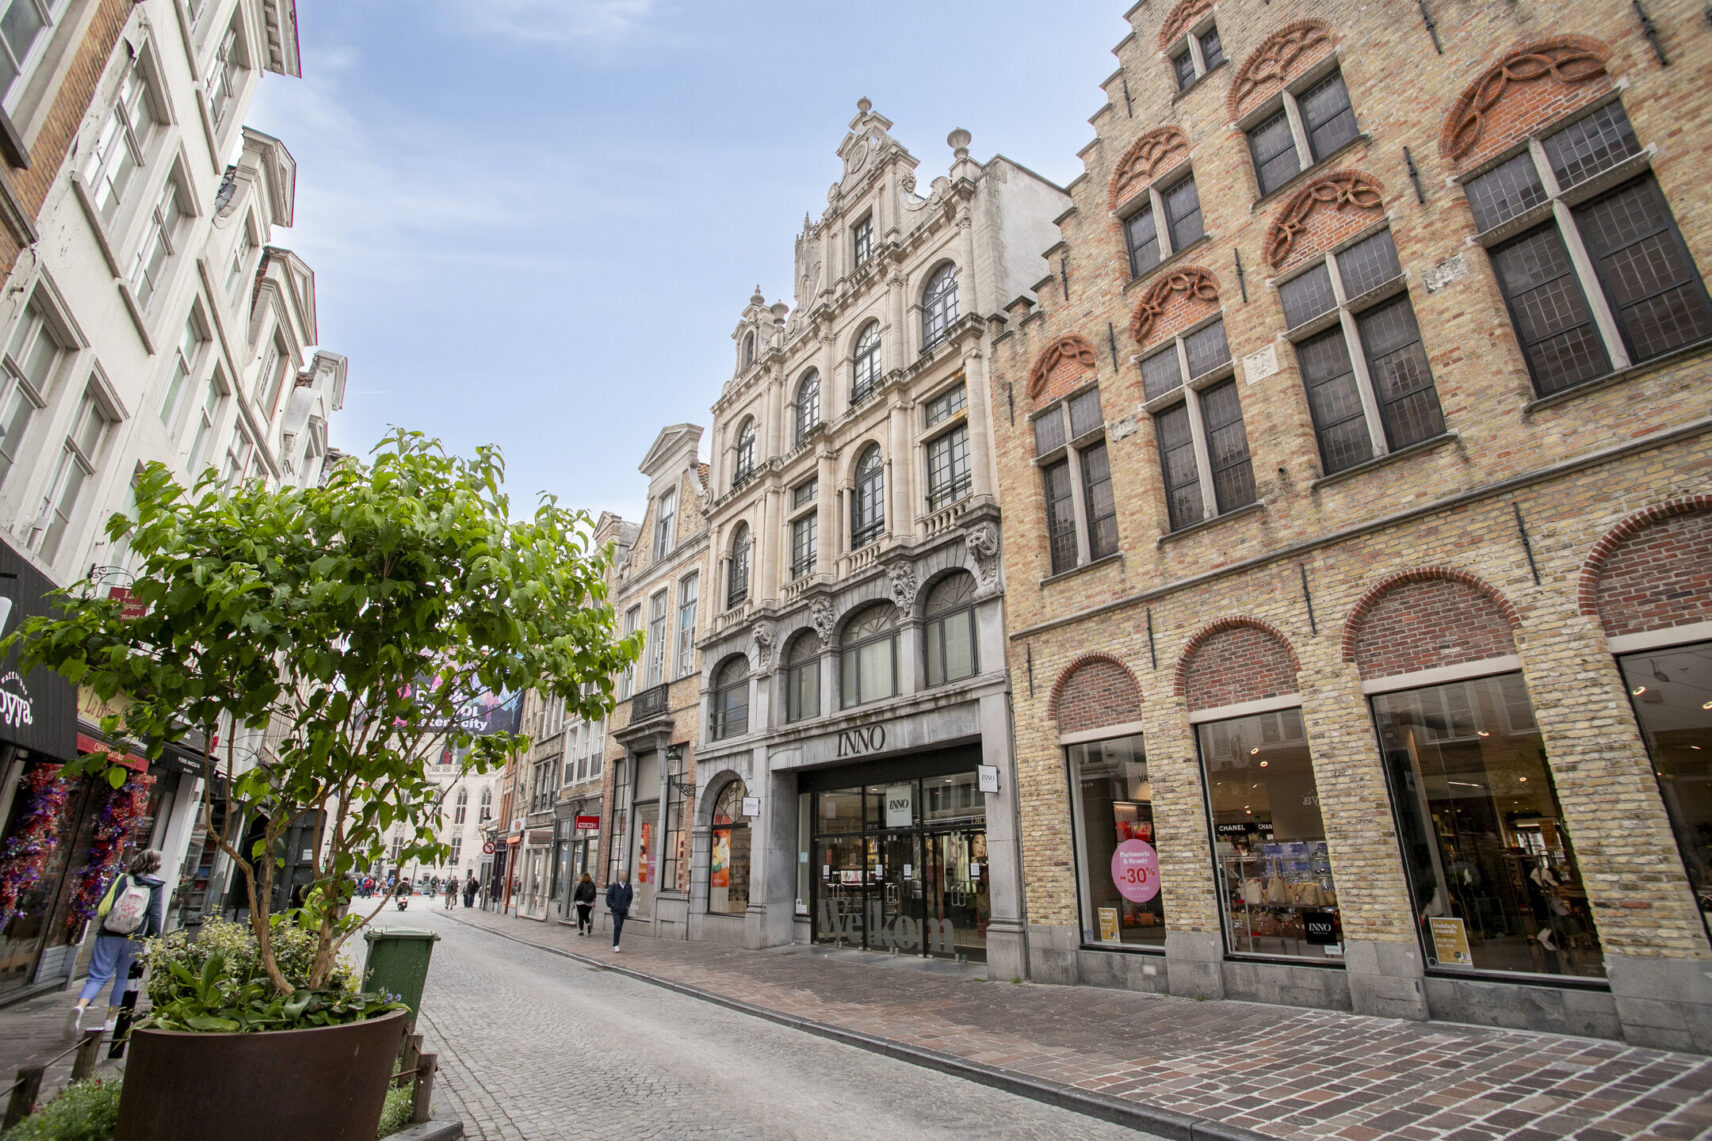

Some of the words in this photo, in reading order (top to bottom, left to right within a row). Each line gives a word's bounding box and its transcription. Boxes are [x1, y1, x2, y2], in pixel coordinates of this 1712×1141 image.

[461, 719, 488, 731] city
[836, 724, 886, 757] INNO
[889, 799, 909, 810] INNO
[1218, 824, 1246, 832] CHANEL
[1257, 823, 1273, 831] CHAN
[1119, 866, 1156, 884] -30%
[817, 899, 955, 954] Welkom
[1308, 922, 1332, 932] INNO
